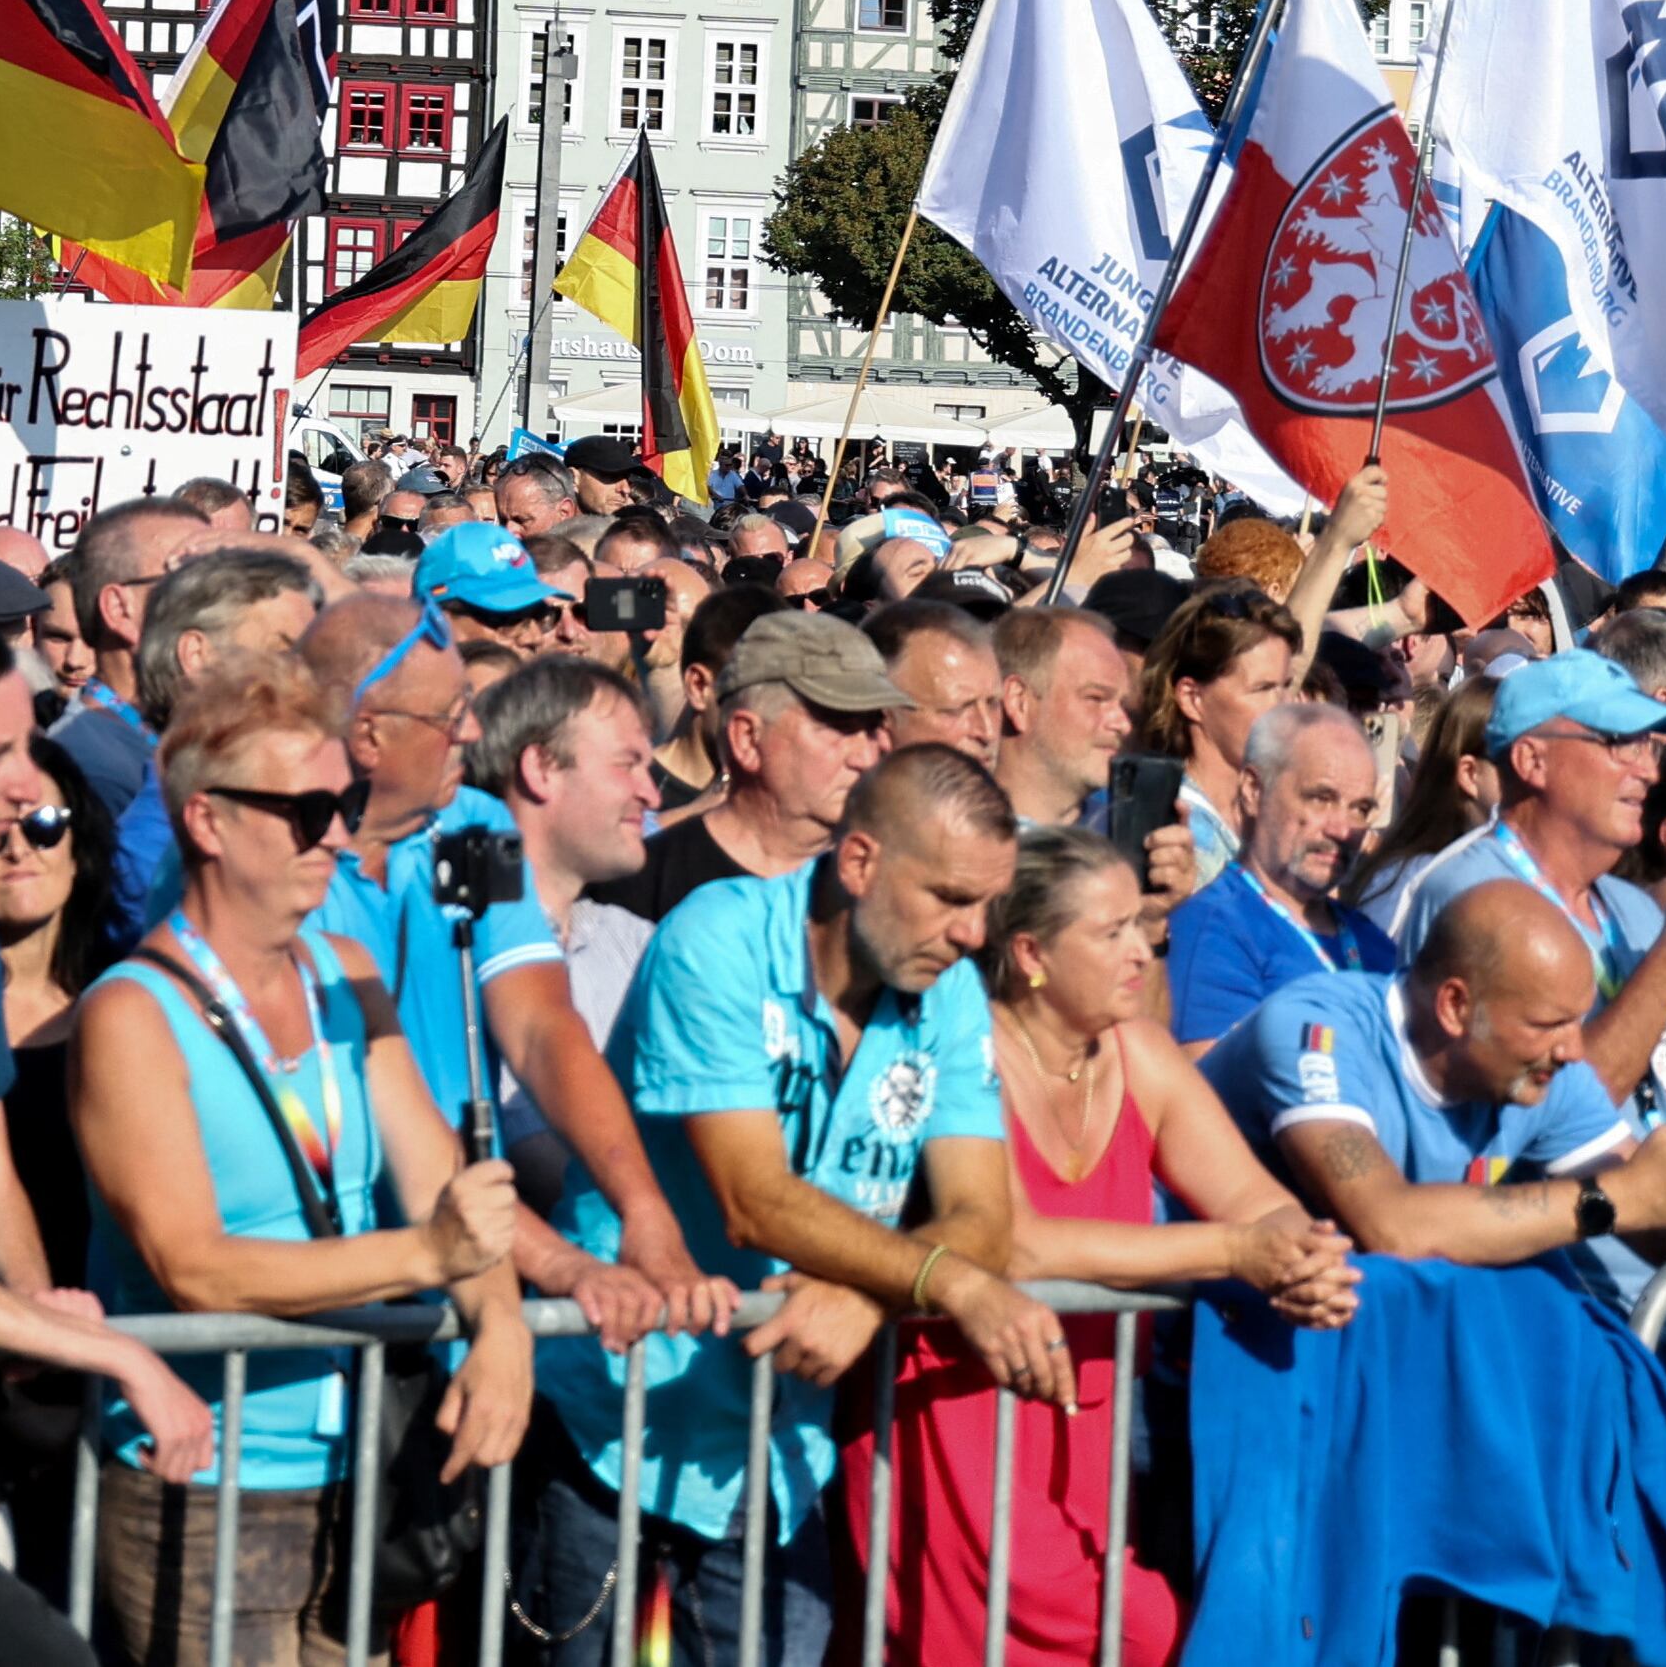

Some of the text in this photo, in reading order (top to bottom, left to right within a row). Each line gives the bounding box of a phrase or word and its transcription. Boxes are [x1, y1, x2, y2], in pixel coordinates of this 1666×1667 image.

[1090, 252, 1156, 314] JUNG
[1542, 169, 1628, 327] BRANDENBURG
[1023, 281, 1171, 405] BRANDENBRG
[1037, 256, 1183, 380] ALTERNAVE
